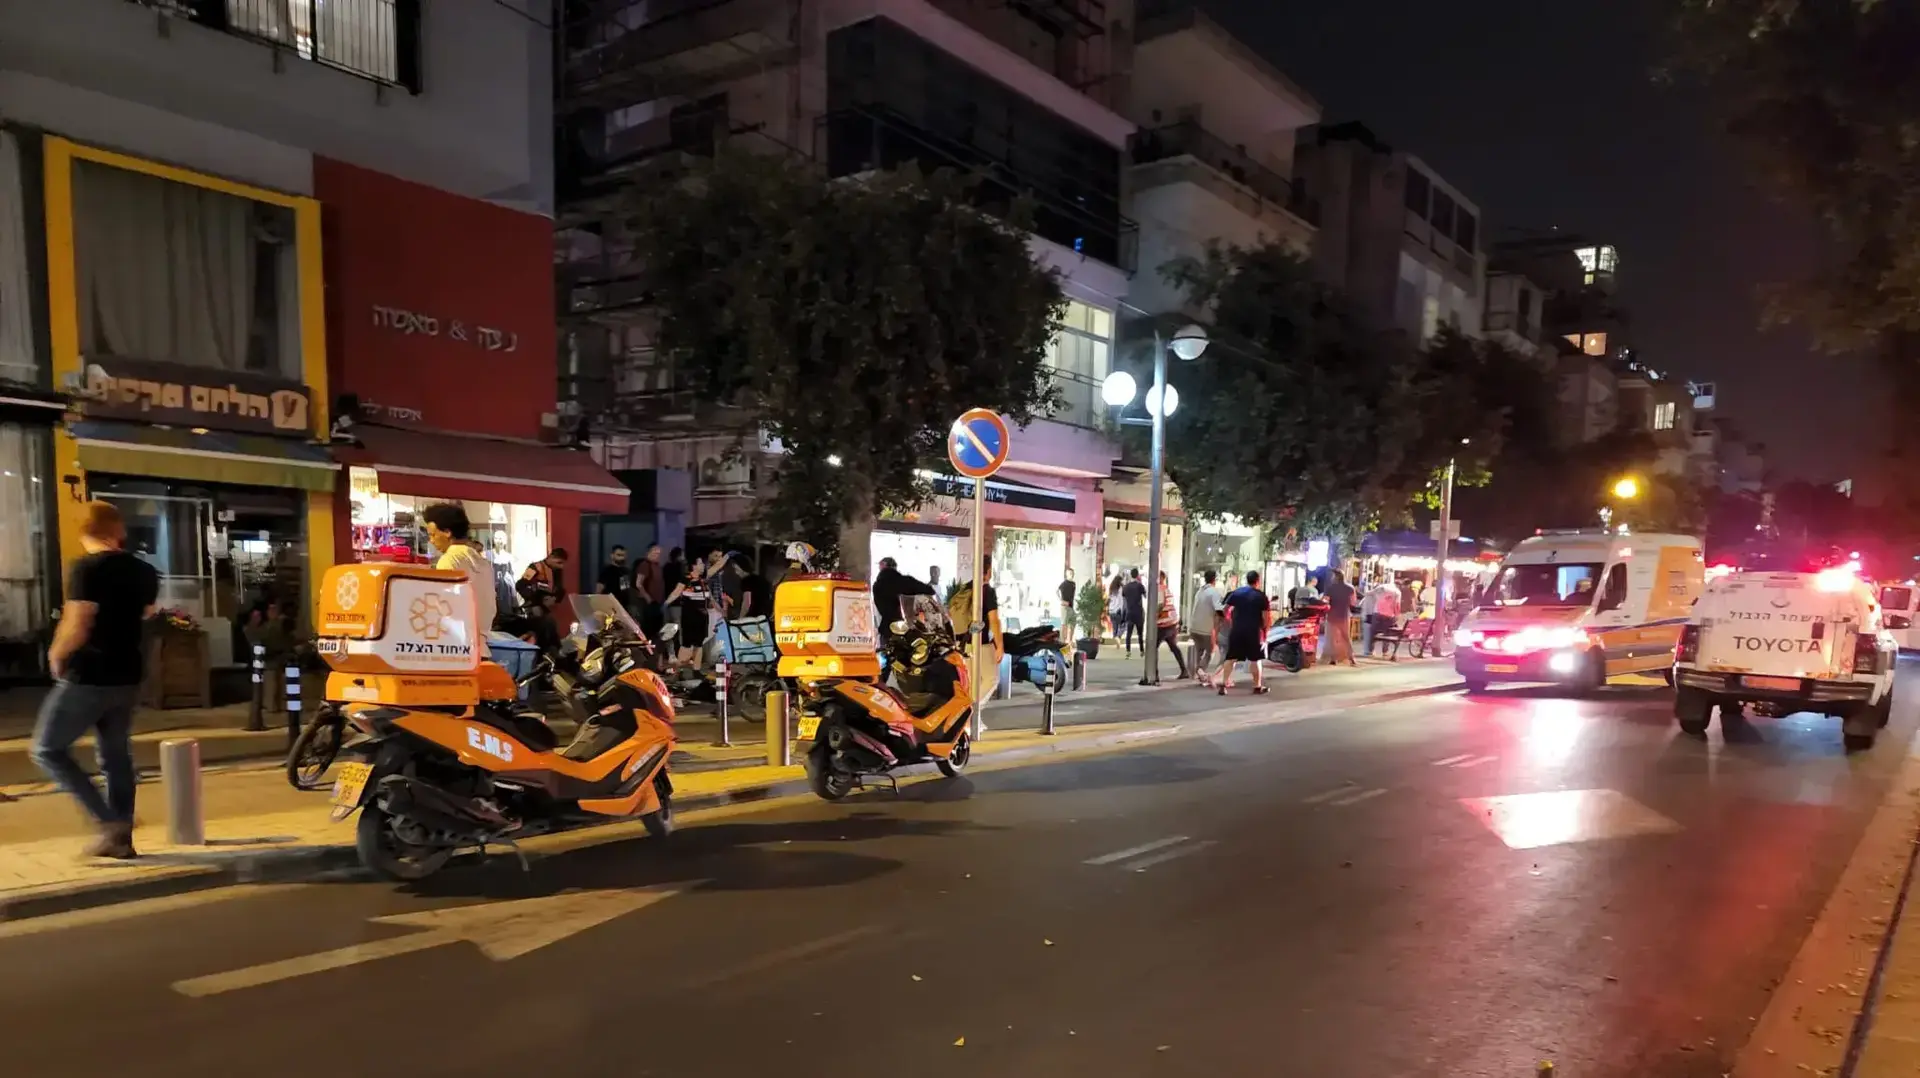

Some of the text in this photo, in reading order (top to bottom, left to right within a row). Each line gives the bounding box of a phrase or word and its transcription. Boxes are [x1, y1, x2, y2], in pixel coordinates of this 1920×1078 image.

[450, 319, 468, 341] &
[190, 383, 269, 419] הלחם
[395, 642, 471, 655] איחוד הצלה
[837, 635, 855, 643] הצלה
[1732, 635, 1822, 655] TOYOTA
[466, 726, 513, 762] E.M.S
